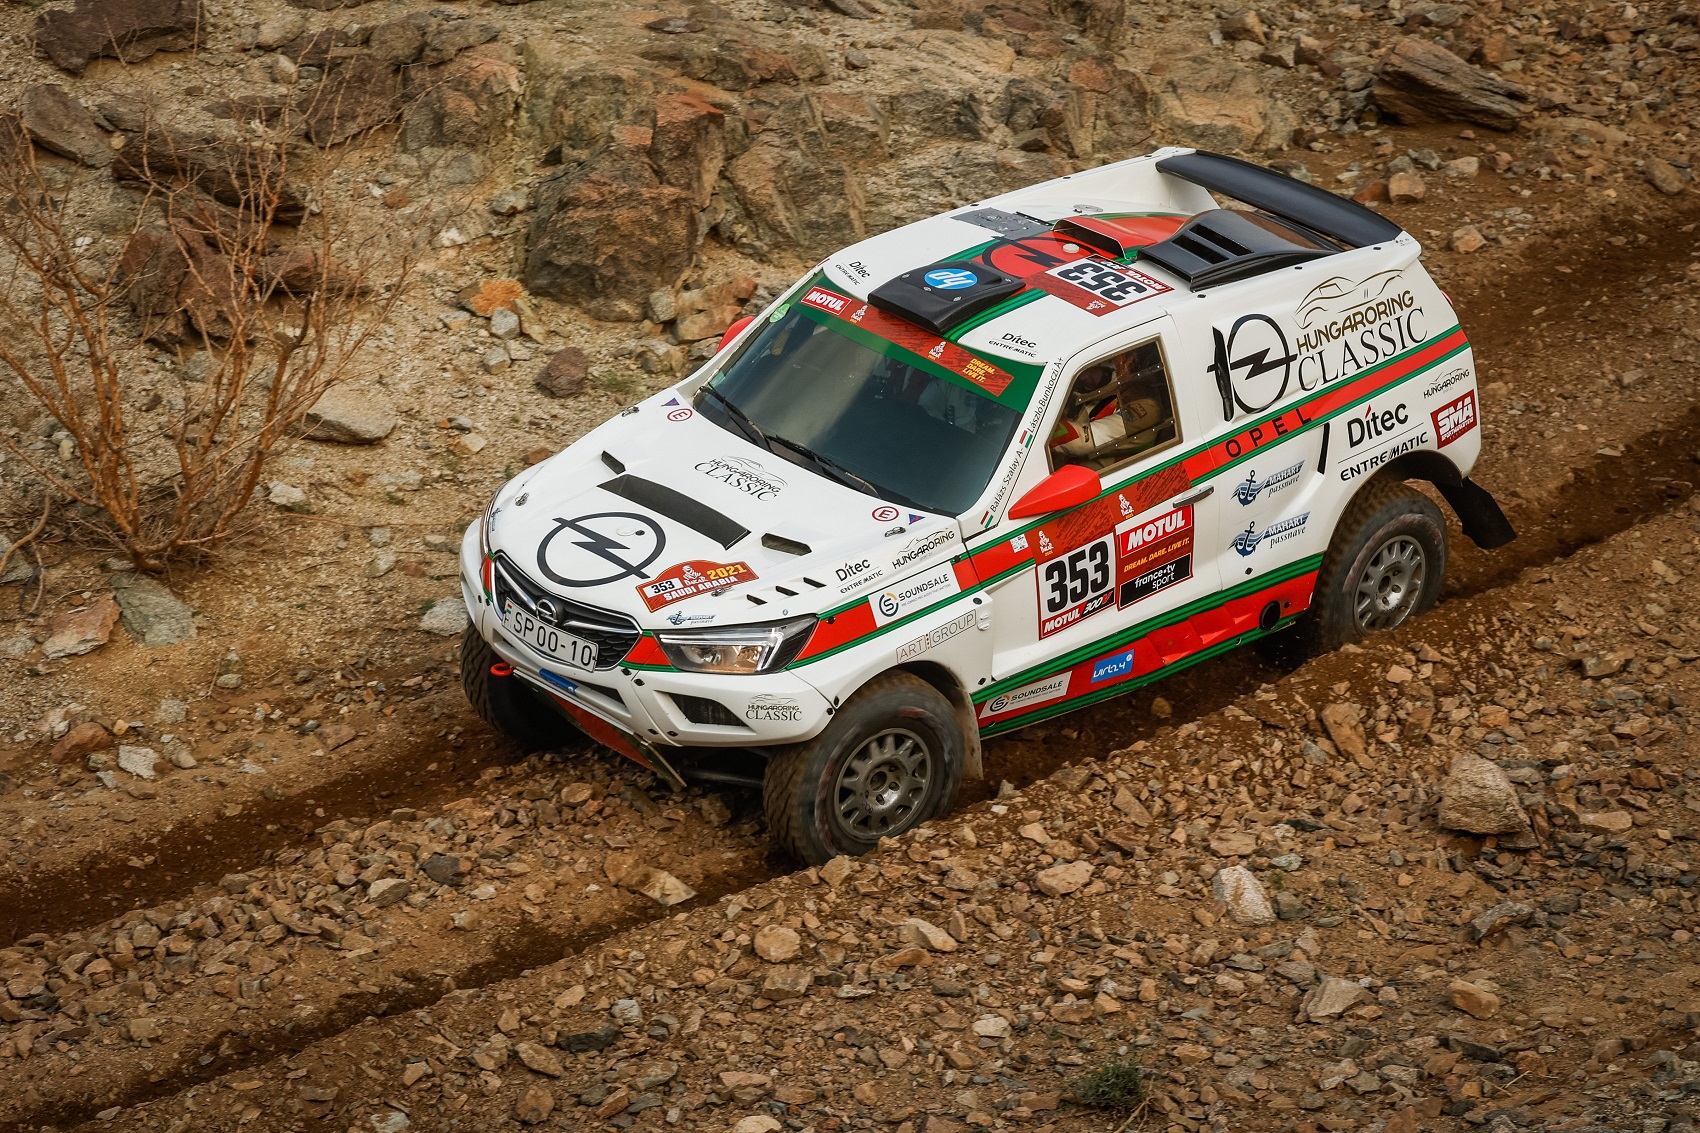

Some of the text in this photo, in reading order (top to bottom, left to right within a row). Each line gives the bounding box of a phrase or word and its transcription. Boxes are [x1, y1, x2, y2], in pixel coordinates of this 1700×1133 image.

[1057, 263, 1147, 301] 353
[1125, 270, 1166, 290] MOTUL
[806, 290, 846, 311] MOTUL
[1296, 290, 1414, 356] HUNGARORING
[1298, 306, 1428, 392] CLASSIC
[970, 358, 996, 375] DREAM.
[1423, 369, 1470, 399] HUNGARORING
[1027, 405, 1044, 433] László
[1437, 396, 1474, 435] SMA
[694, 462, 778, 501] CLASSIC
[709, 458, 781, 493] HUNGARORING
[990, 486, 1007, 513] Balázs
[1003, 458, 1020, 485] Szalay
[1268, 464, 1300, 486] MAHART
[1127, 510, 1185, 551] MOTUL
[1268, 515, 1304, 536] MAHART
[1270, 526, 1306, 549] passnave
[892, 530, 955, 569] HUNGARORING
[1124, 558, 1148, 572] DREAM.
[1149, 547, 1167, 561] DARE.
[1168, 541, 1182, 553] LIVE
[706, 564, 747, 580] 2021
[1045, 541, 1109, 613] 353
[1152, 572, 1175, 590] sport
[651, 580, 675, 594] 353
[664, 576, 739, 601] SAUDI ARABIA
[898, 573, 950, 602] SOUNDSALE
[1044, 608, 1080, 633] MOTUL
[900, 613, 973, 660] ART GROUP
[1011, 680, 1063, 701] SOUNDSALE
[745, 709, 802, 721] CLASSIC
